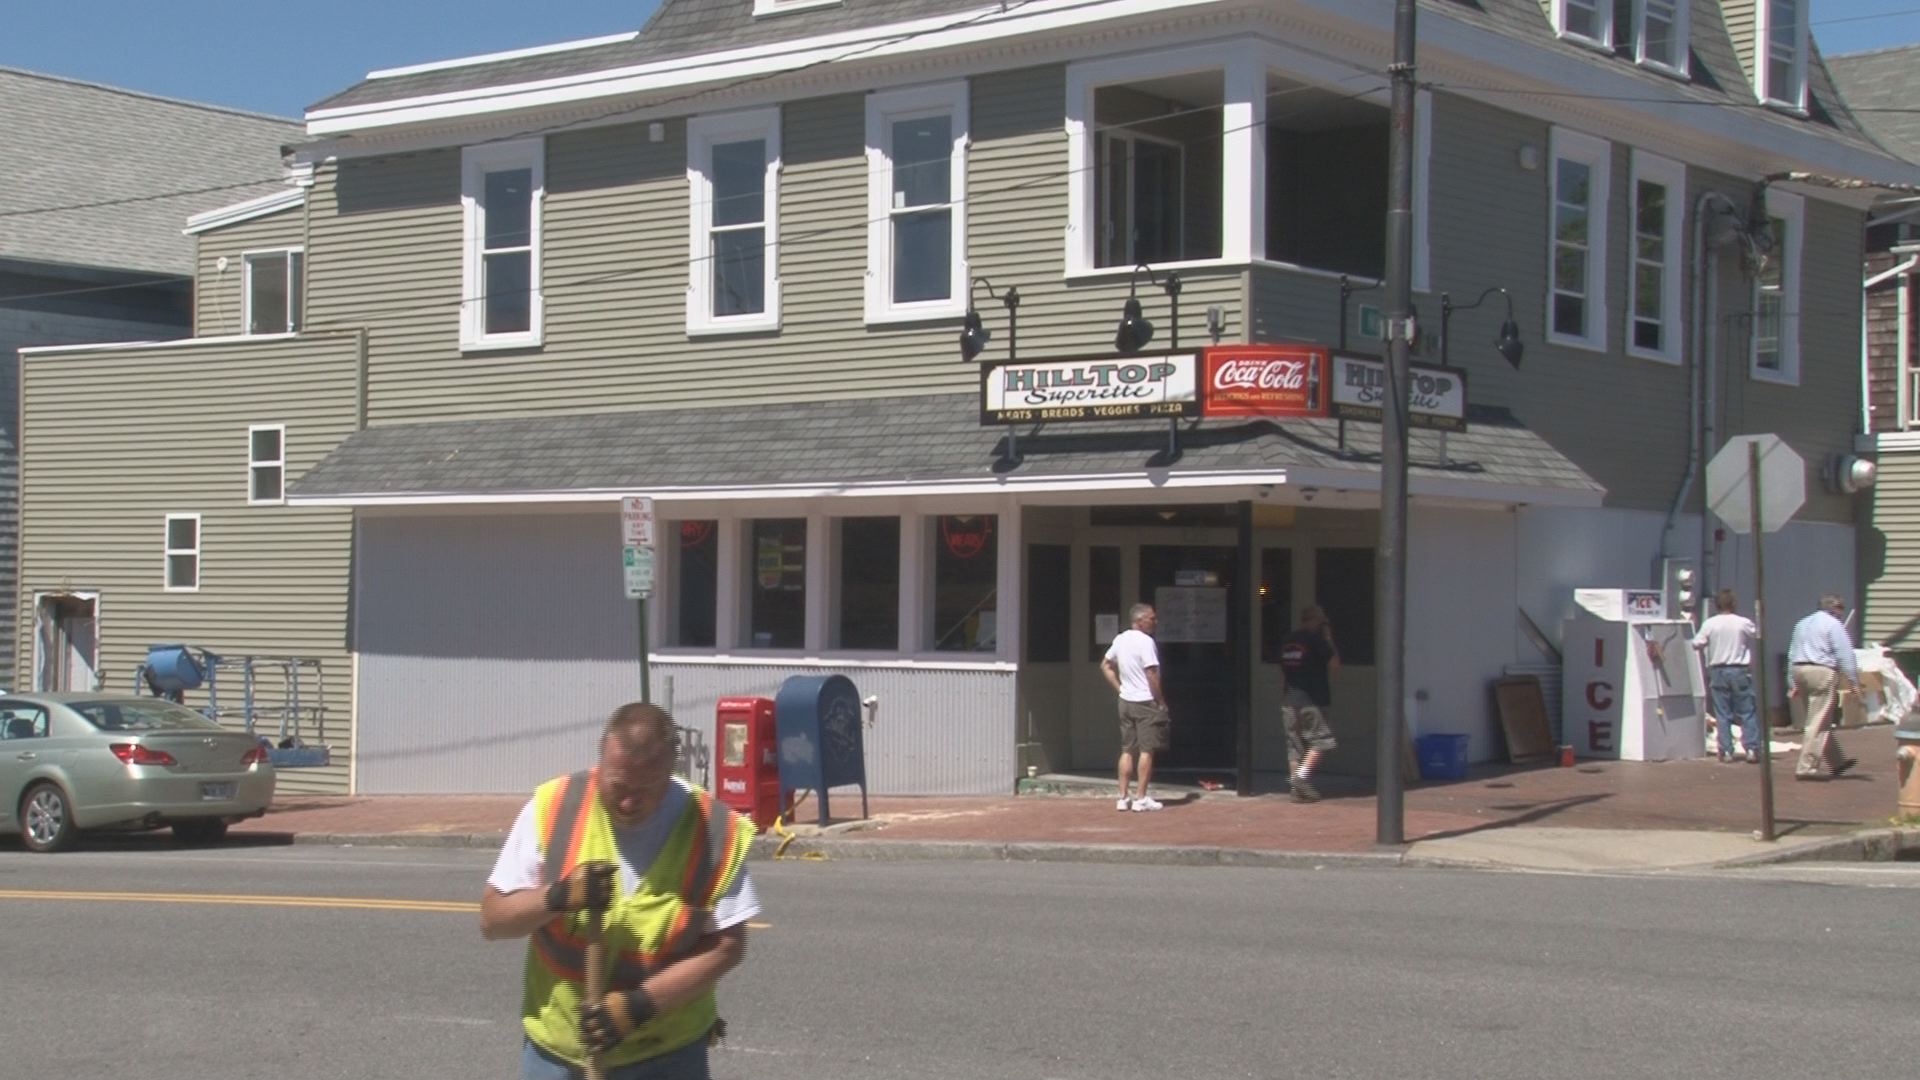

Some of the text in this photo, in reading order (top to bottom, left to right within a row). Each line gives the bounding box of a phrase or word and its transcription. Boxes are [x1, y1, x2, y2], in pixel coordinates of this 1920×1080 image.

[1005, 362, 1176, 391] HILLTOP
[1214, 360, 1305, 389] Coca-Cola
[1345, 362, 1453, 397] HIOP
[1024, 386, 1154, 405] Superette
[1041, 406, 1084, 419] BREADS
[1093, 403, 1140, 416] VEGGIES
[631, 501, 644, 510] NO
[1636, 595, 1653, 609] ICE
[1585, 638, 1613, 752] ICE
